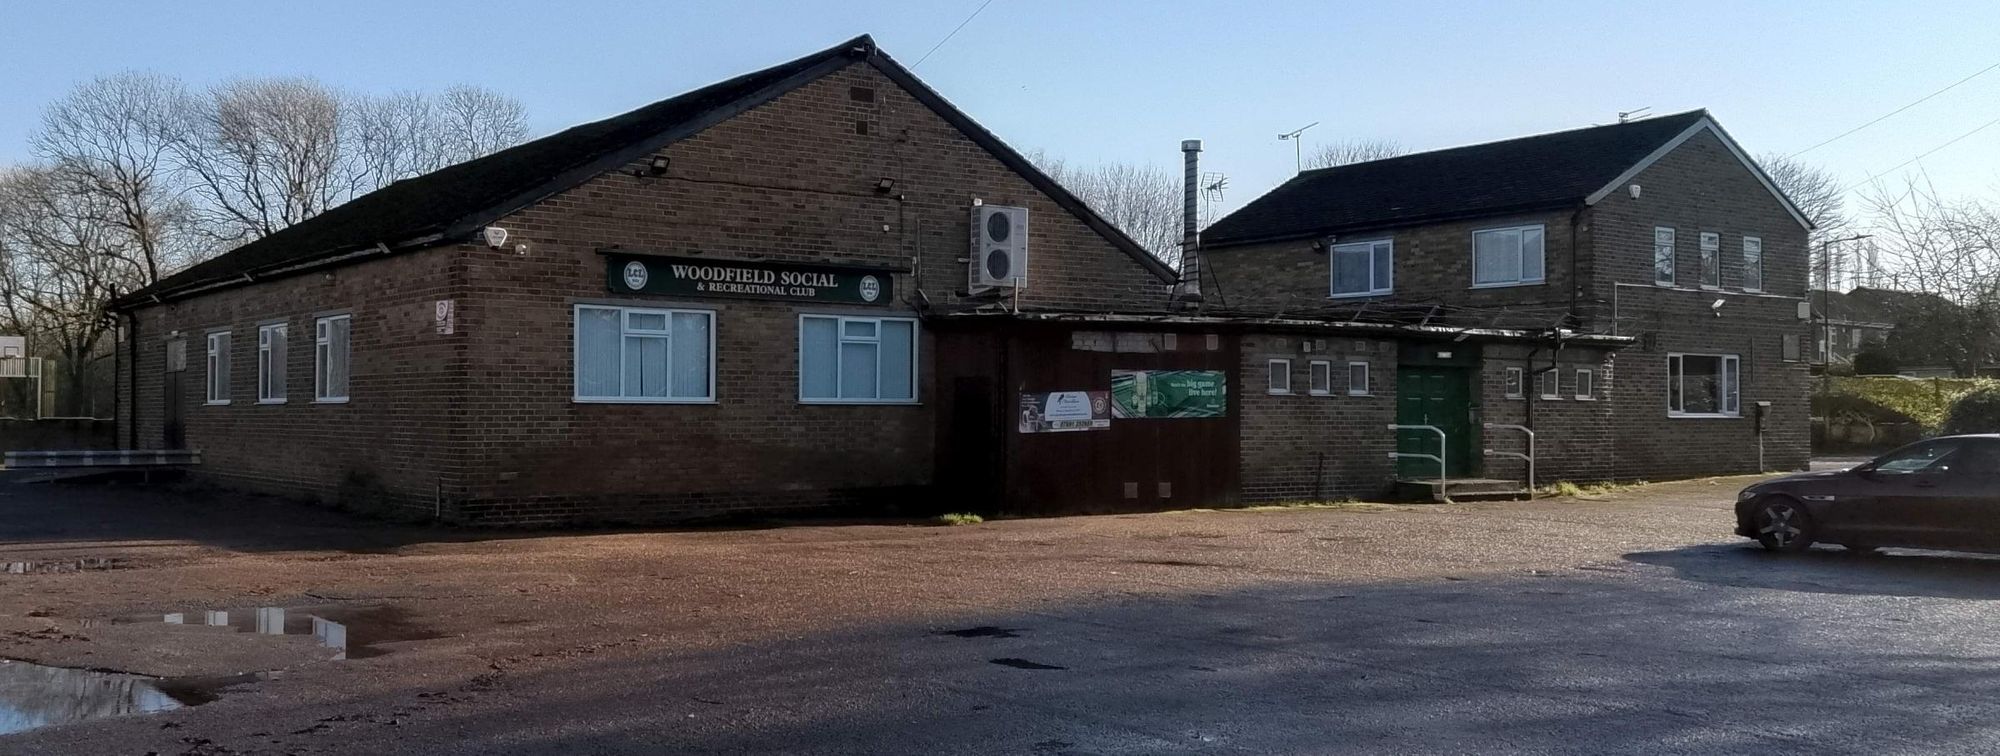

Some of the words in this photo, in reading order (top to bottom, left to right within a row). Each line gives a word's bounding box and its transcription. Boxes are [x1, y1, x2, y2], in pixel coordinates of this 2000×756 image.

[671, 264, 776, 285] WOODFIELD
[780, 271, 838, 288] SOCIAL
[696, 281, 705, 292] &
[709, 282, 787, 296] RECREATIONAL
[789, 287, 816, 297] CLUB
[1186, 379, 1197, 388] big
[1188, 388, 1200, 396] live
